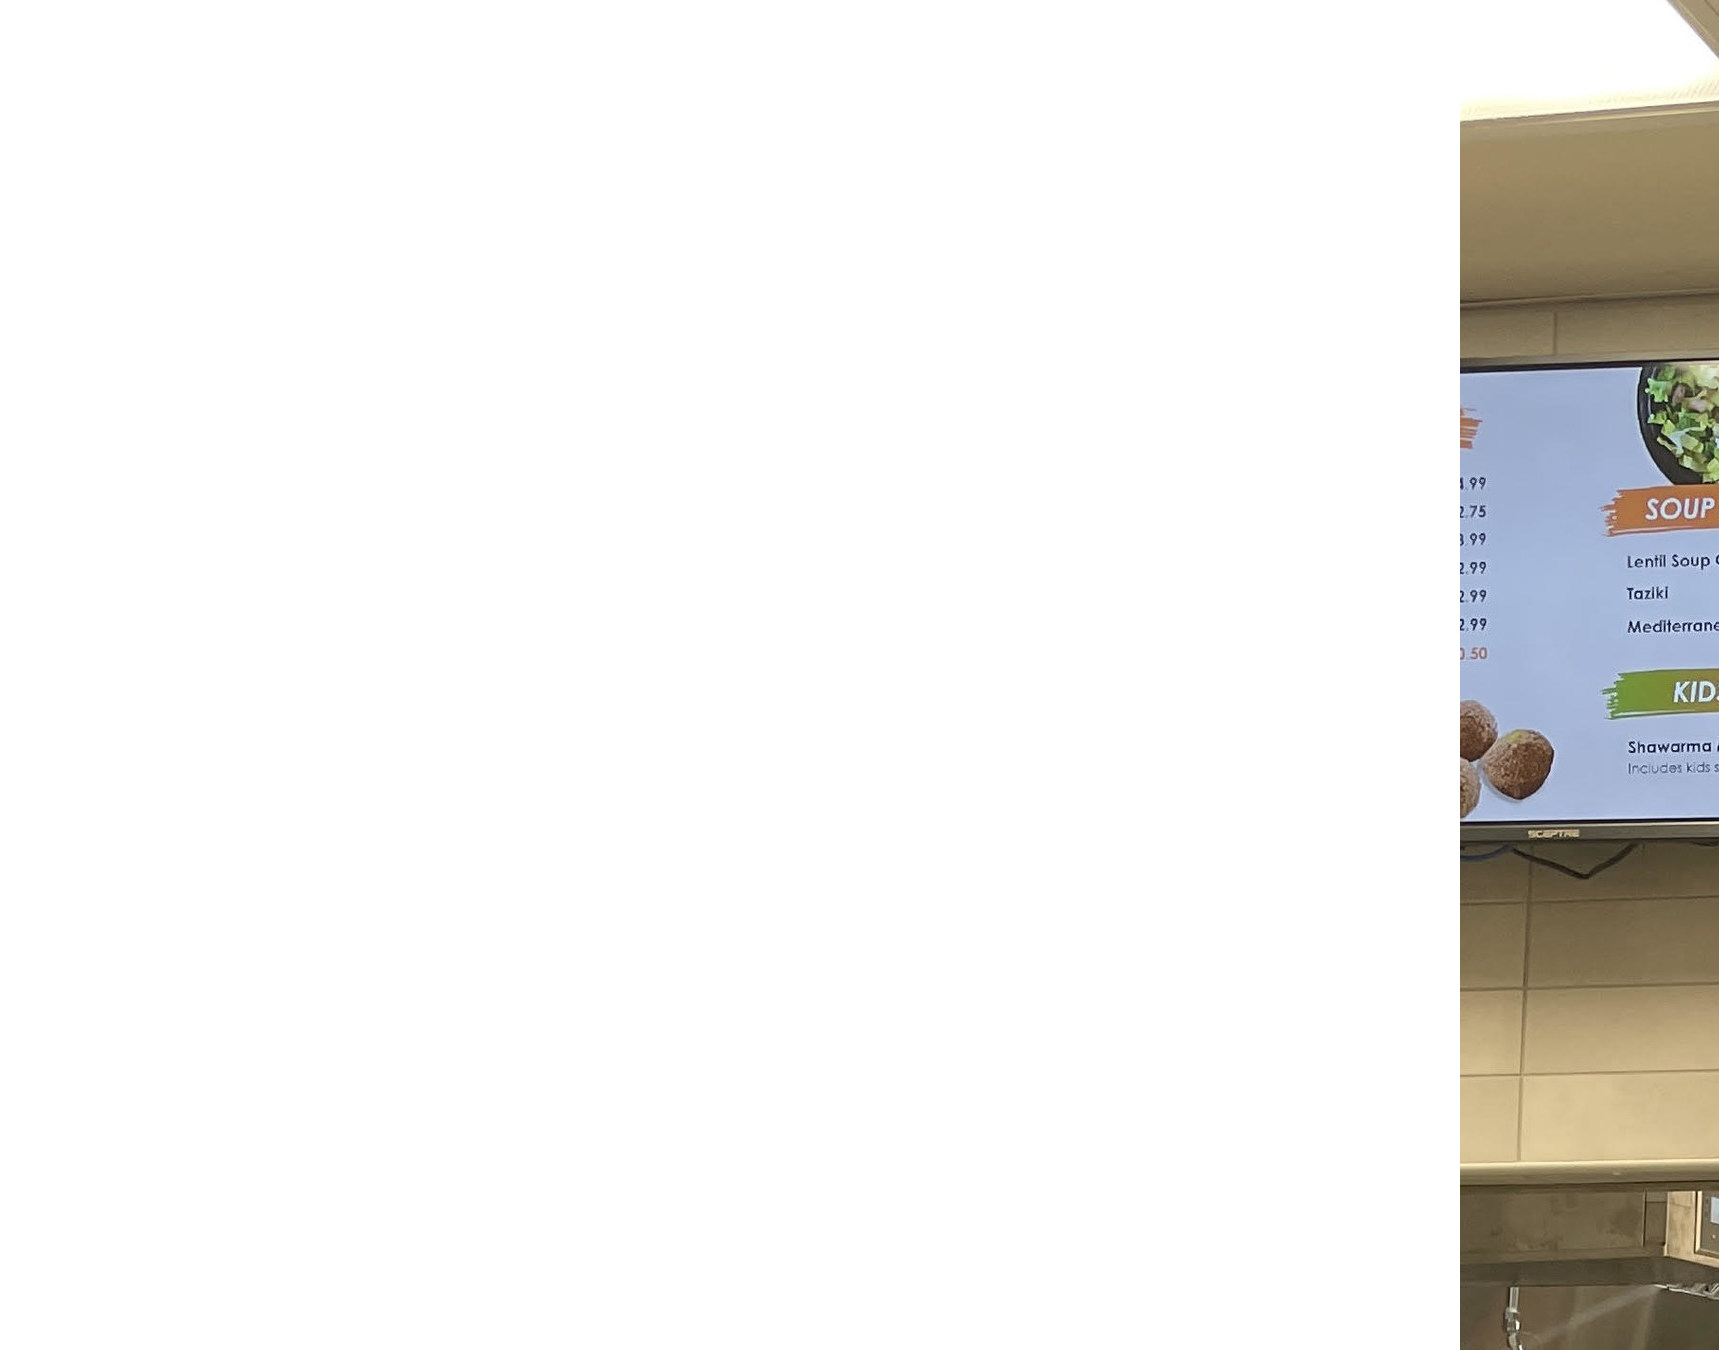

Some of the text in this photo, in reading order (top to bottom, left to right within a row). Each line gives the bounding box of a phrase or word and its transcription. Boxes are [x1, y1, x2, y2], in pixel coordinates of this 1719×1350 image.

[1645, 497, 1715, 521] SOUP
[1627, 553, 1667, 569] Lentil
[1671, 553, 1711, 571] Soup
[1626, 585, 1669, 601] Taziki
[1627, 740, 1712, 754] Shawarma
